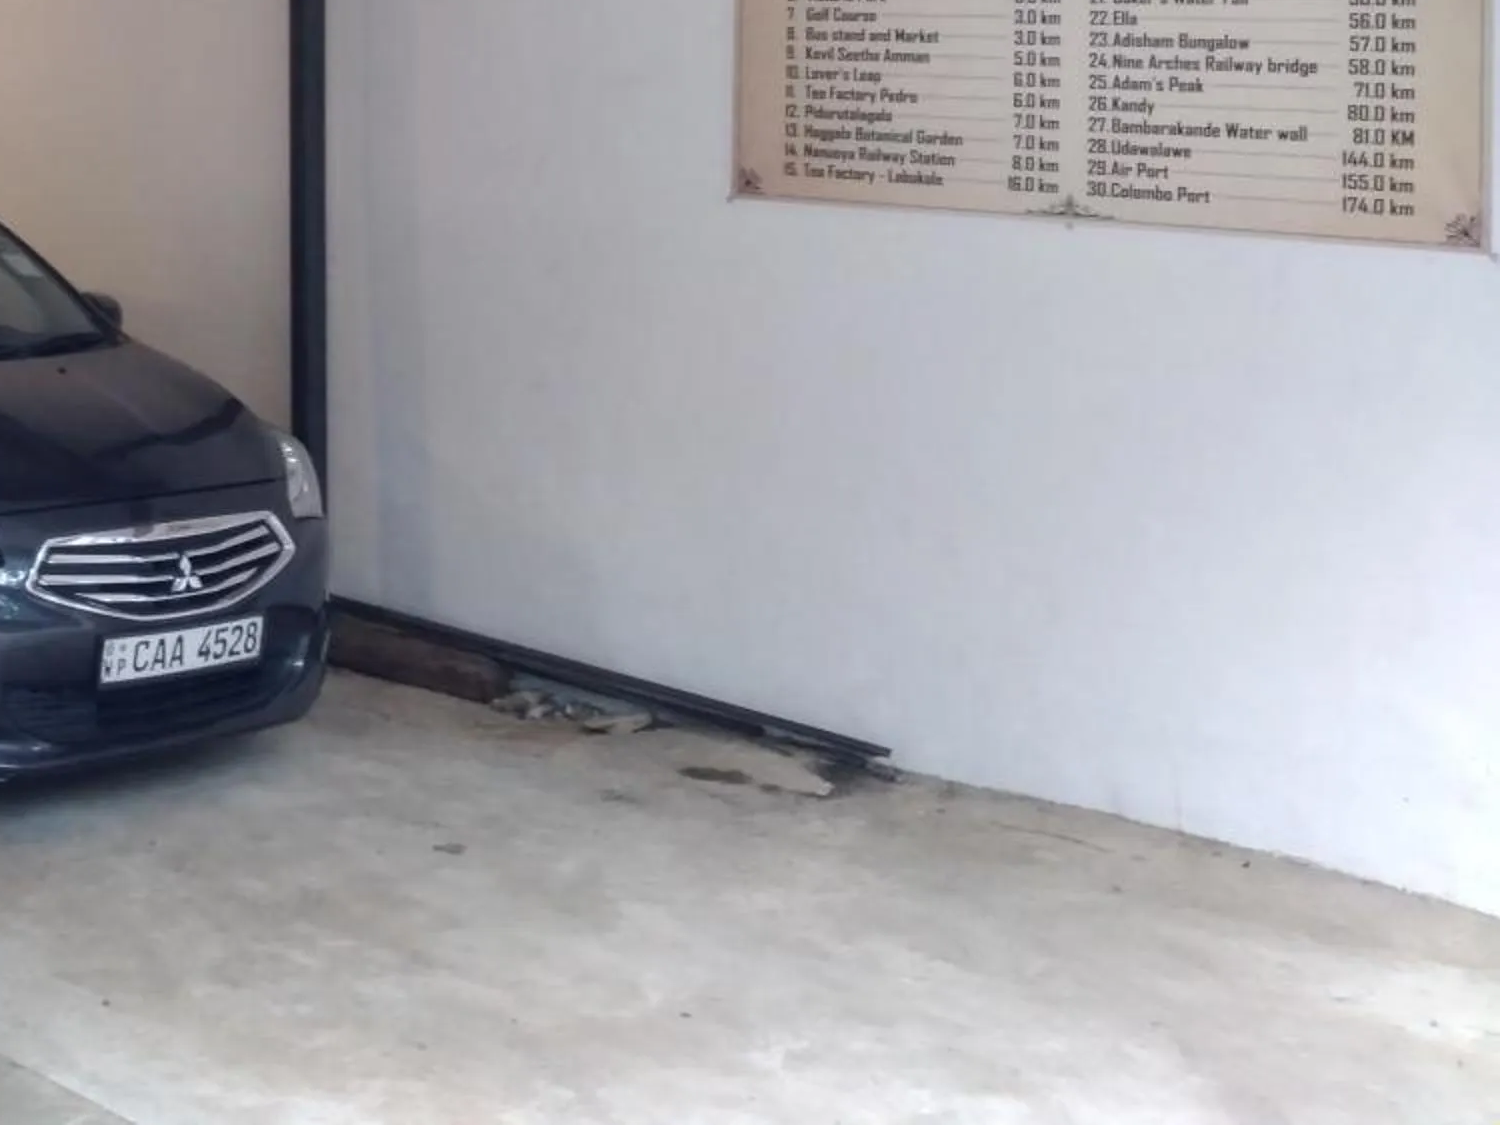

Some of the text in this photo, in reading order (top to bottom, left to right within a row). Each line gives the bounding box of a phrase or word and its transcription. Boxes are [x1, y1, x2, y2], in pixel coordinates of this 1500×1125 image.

[1013, 7, 1037, 26] 3.0
[1039, 9, 1062, 25] km
[1348, 11, 1387, 31] 56.0
[1390, 12, 1416, 30] km
[804, 25, 828, 41] Bus
[831, 27, 866, 42] stand
[868, 27, 891, 43] and
[893, 27, 939, 44] Market
[1013, 28, 1037, 46] 3.0
[1039, 30, 1061, 46] km
[1177, 32, 1250, 54] Bungalow
[1348, 33, 1387, 53] 57.0
[1390, 35, 1416, 54] km
[1013, 49, 1037, 67] 5.0
[1039, 51, 1061, 68] km
[1147, 53, 1201, 72] Arches
[1204, 54, 1263, 76] Railway
[1266, 56, 1318, 78] bridge
[1347, 57, 1387, 77] 58.0
[1389, 58, 1416, 77] km
[1038, 72, 1061, 89] km
[1168, 75, 1204, 93] Peak
[1389, 81, 1416, 101] km
[805, 83, 827, 100] Tea
[828, 85, 877, 104] Factory
[1038, 94, 1061, 110] km
[1012, 112, 1036, 130] 7.0
[1038, 113, 1061, 131] km
[1346, 103, 1386, 123] 80.0
[1389, 105, 1416, 124] km
[854, 125, 1060, 152] Botanical Garden 7.0 km
[1224, 121, 1273, 141] Water
[1389, 128, 1416, 148] KM
[858, 145, 907, 166] Railway
[909, 148, 956, 167] Station
[1038, 156, 1060, 173] km
[1341, 149, 1386, 169] 144.0
[1389, 152, 1415, 171] km
[803, 161, 825, 178] Tea
[827, 163, 875, 184] Factory
[1037, 177, 1060, 194] km
[1135, 161, 1169, 180] Port
[1341, 171, 1386, 193] 155.0
[1389, 175, 1415, 194] km
[1176, 185, 1210, 205] Port
[1341, 195, 1386, 216] 174.0
[1389, 197, 1415, 217] km
[132, 622, 258, 672] CAA 4528
